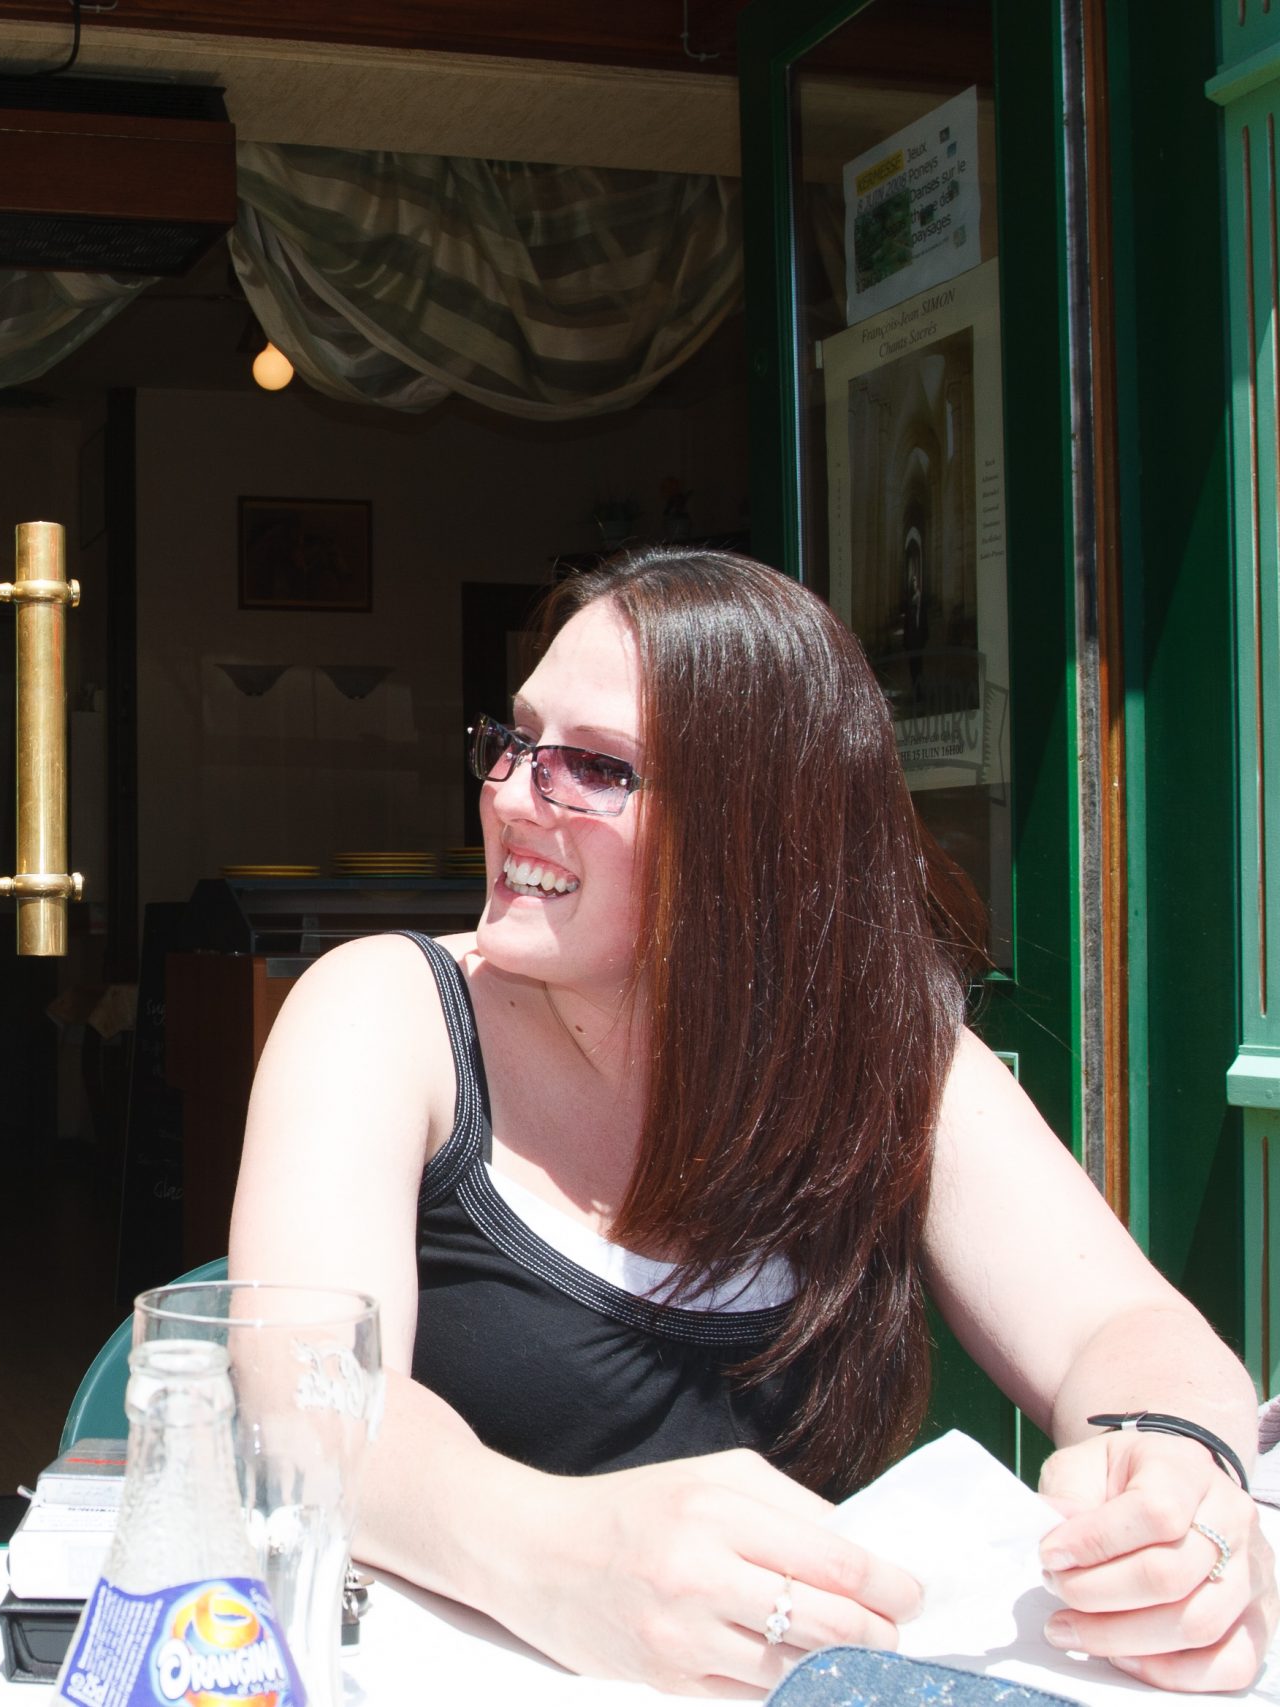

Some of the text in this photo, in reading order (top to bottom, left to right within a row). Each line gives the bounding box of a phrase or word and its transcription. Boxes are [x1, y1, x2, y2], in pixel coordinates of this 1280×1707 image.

[907, 144, 927, 163] Jeux
[909, 158, 938, 182] Poneys
[910, 160, 966, 203] Danses sur le
[911, 215, 952, 246] paysages
[920, 287, 956, 316] SIMON
[879, 337, 908, 358] Chants
[922, 747, 939, 760] JUIN
[158, 1638, 286, 1699] ORANGINA
